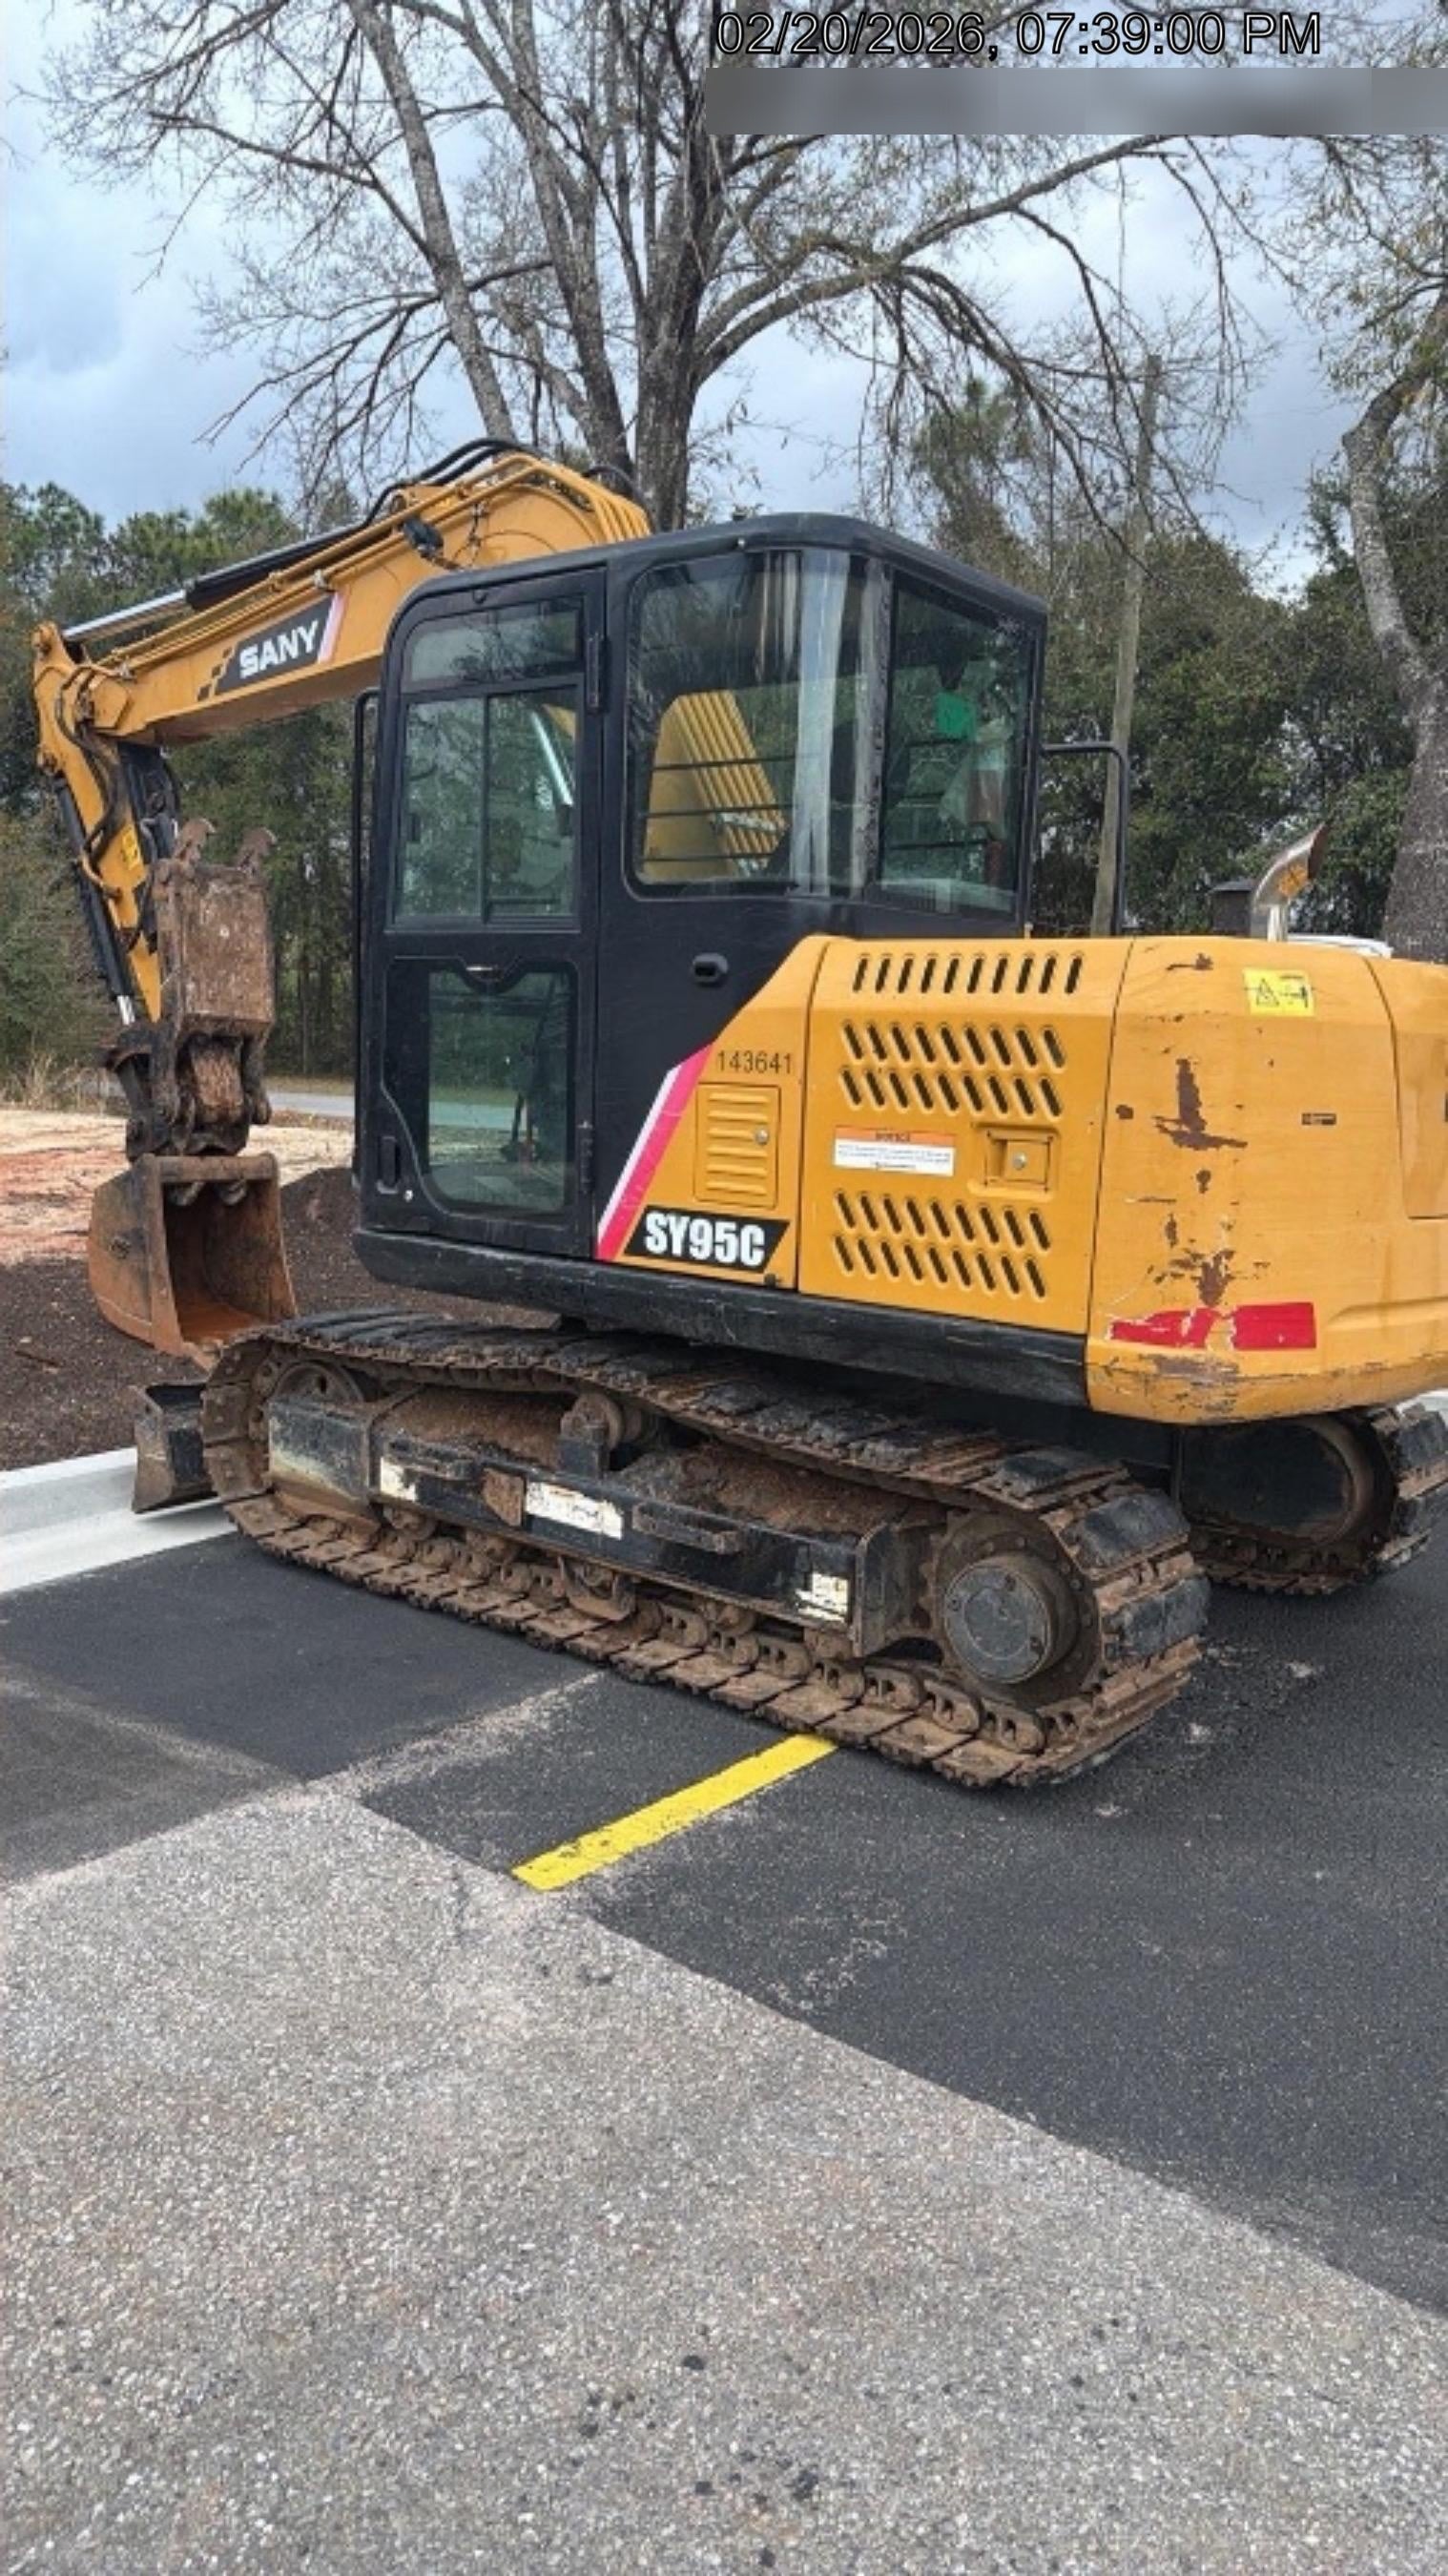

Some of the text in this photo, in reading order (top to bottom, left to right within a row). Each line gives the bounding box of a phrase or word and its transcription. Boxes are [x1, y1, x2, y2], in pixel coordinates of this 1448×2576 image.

[239, 618, 319, 679] SANY
[717, 1049, 792, 1074] 143641
[644, 1211, 765, 1267] SY95C
